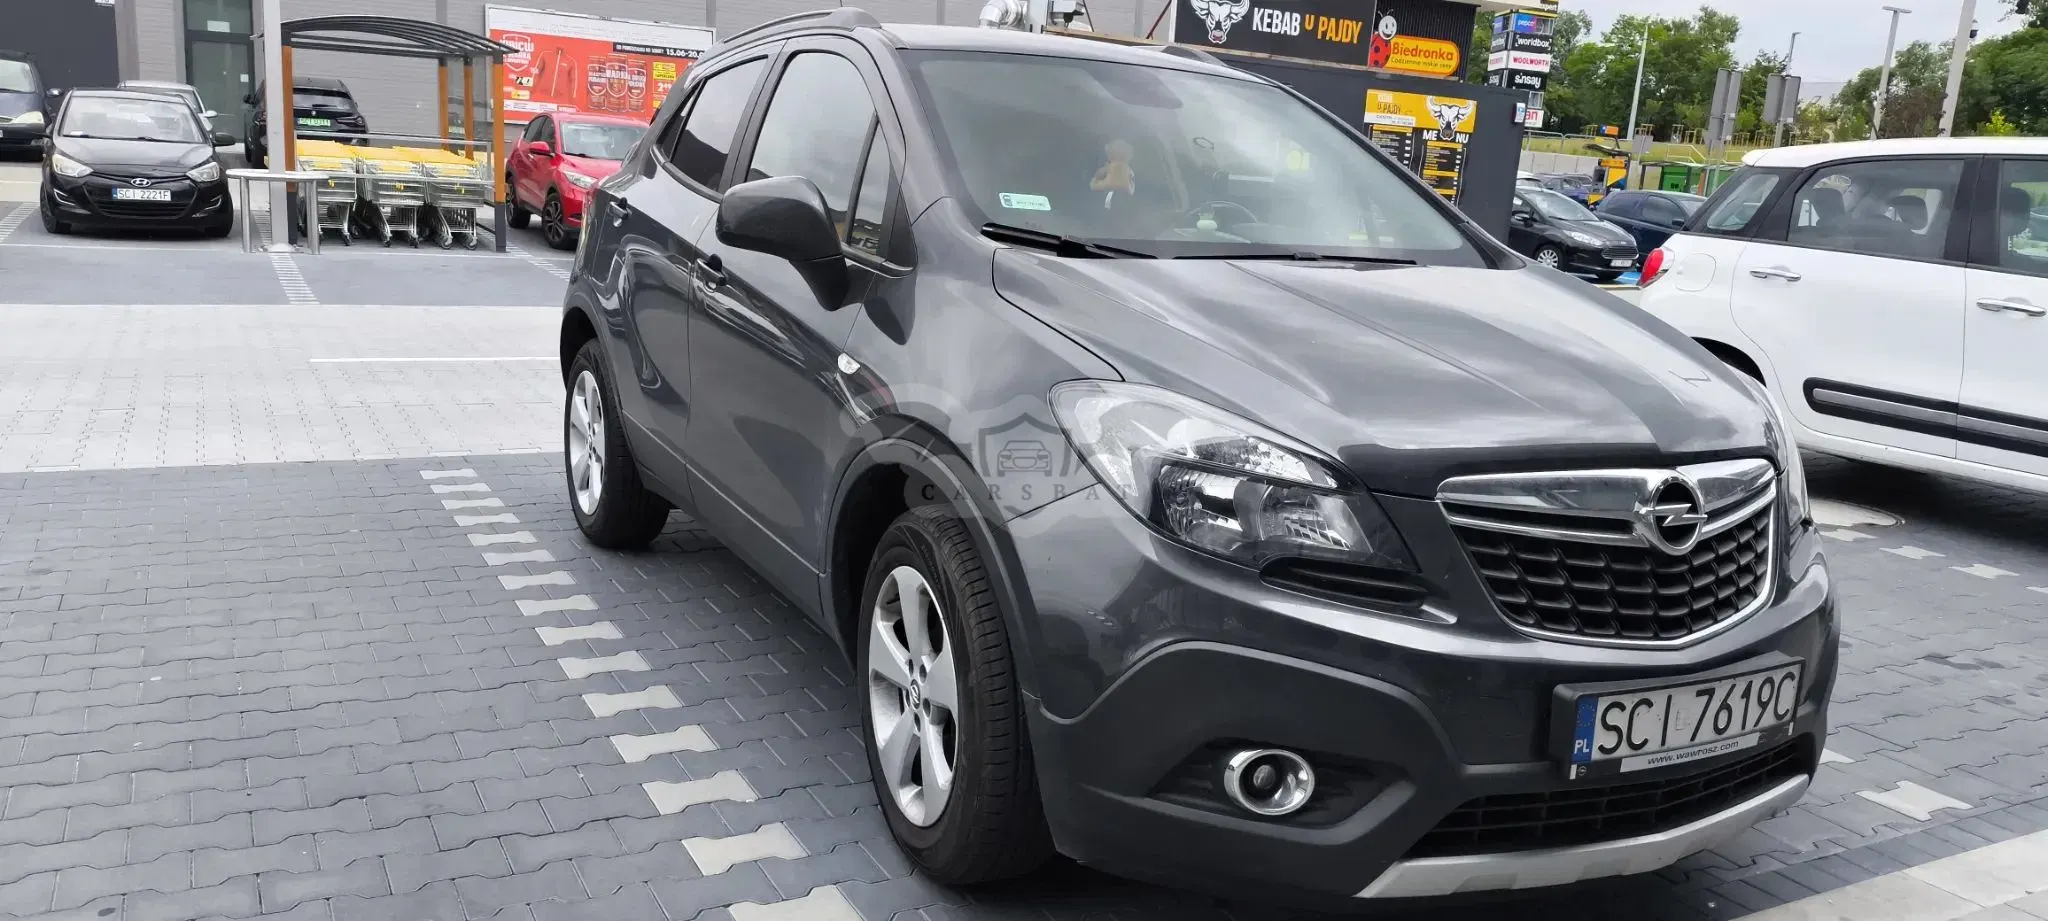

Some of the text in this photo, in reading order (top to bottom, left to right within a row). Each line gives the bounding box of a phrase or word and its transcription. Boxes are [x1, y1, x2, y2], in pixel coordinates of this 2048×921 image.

[1252, 7, 1300, 36] KEBAB
[1317, 19, 1362, 44] PAJDY
[1392, 41, 1454, 61] Biedronka
[1517, 38, 1550, 48] worldbox
[1514, 73, 1541, 89] sinsay
[1598, 671, 1797, 755] SCI 7619C
[1574, 738, 1590, 755] PL
[1647, 740, 1739, 765] www.wawrosz.com
